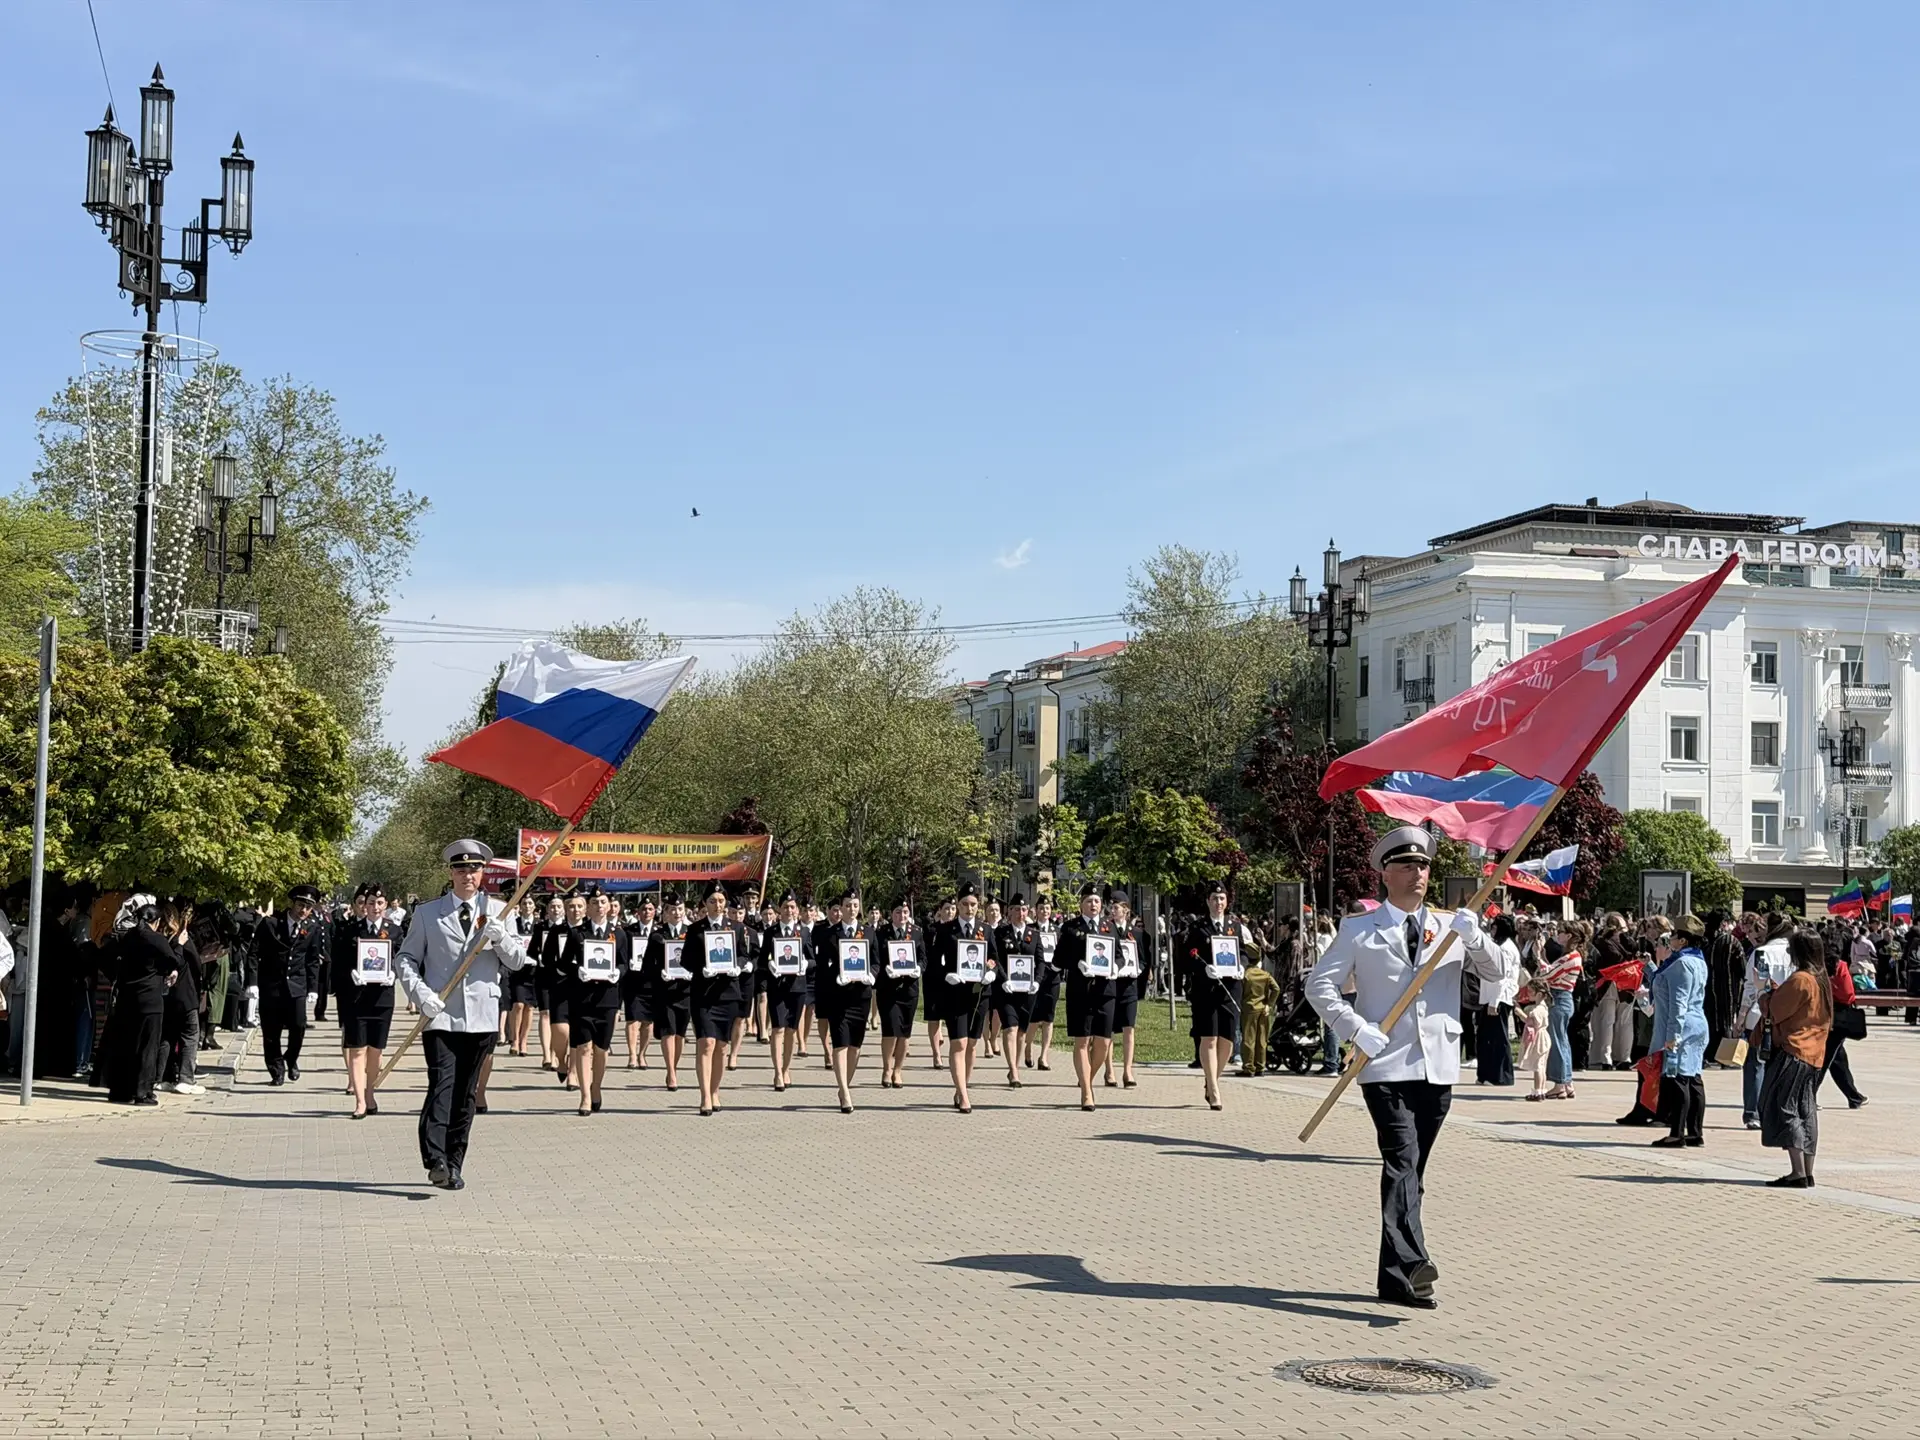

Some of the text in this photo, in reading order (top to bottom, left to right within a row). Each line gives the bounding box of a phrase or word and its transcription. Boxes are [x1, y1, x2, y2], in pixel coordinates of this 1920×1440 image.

[1638, 535, 1750, 561] СЛАВА
[1763, 540, 1887, 569] ГЕРОЯМ
[578, 842, 720, 855] МЫ ПОМНИМ ПОДВИГ ВЕТЕРАНОВ!
[571, 859, 603, 870] ЗАКОНУ
[606, 860, 643, 871] СЛУЖИМ
[646, 861, 662, 871] КАК
[665, 861, 688, 872] ОТЦЫ
[691, 861, 697, 871] И
